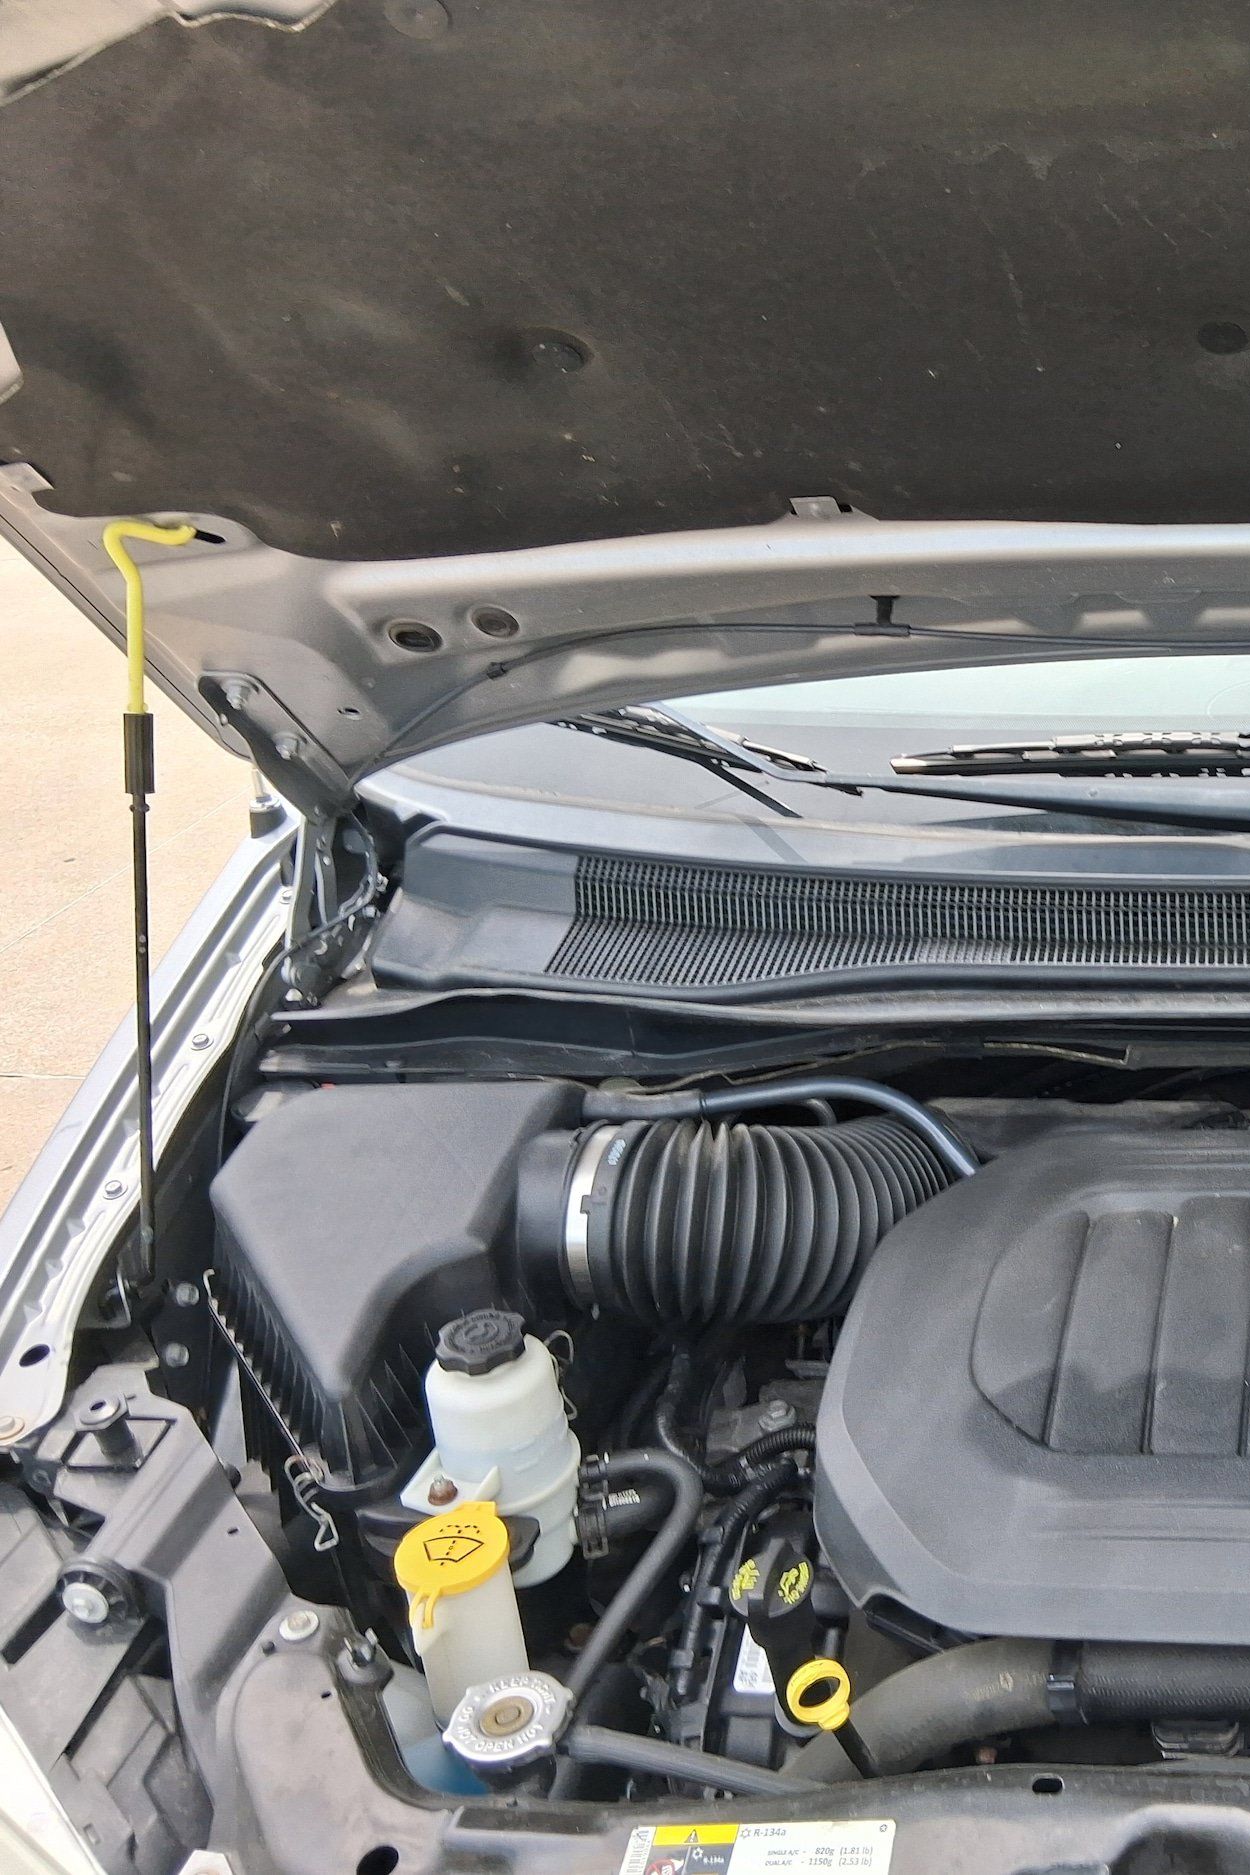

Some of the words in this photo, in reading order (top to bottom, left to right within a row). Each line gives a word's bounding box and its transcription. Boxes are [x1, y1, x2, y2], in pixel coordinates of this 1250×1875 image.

[475, 1740, 514, 1753] OPEN
[753, 1828, 787, 1837] R-134a
[815, 1847, 835, 1856] 820g
[808, 1857, 833, 1867] 1150g
